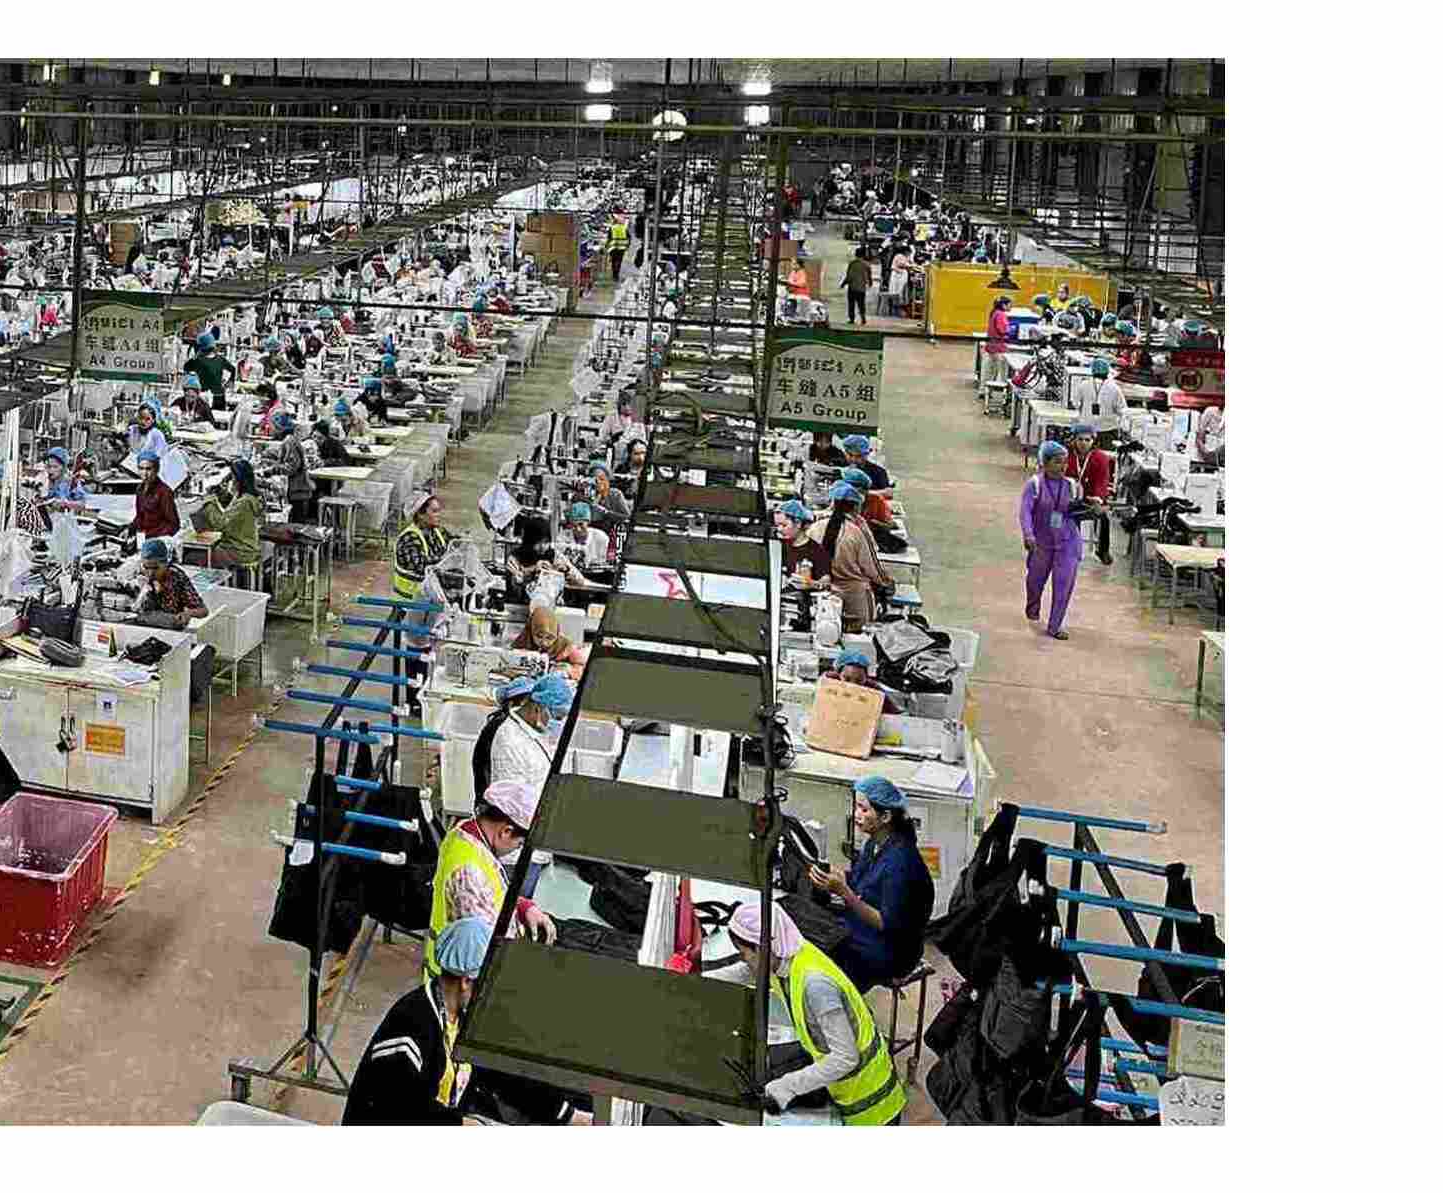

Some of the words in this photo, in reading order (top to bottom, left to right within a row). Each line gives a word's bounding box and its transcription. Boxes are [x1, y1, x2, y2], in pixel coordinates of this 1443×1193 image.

[90, 354, 106, 366] A4
[114, 357, 155, 369] Group
[853, 362, 878, 376] A5
[780, 402, 803, 415] A5
[812, 403, 867, 422] Group
